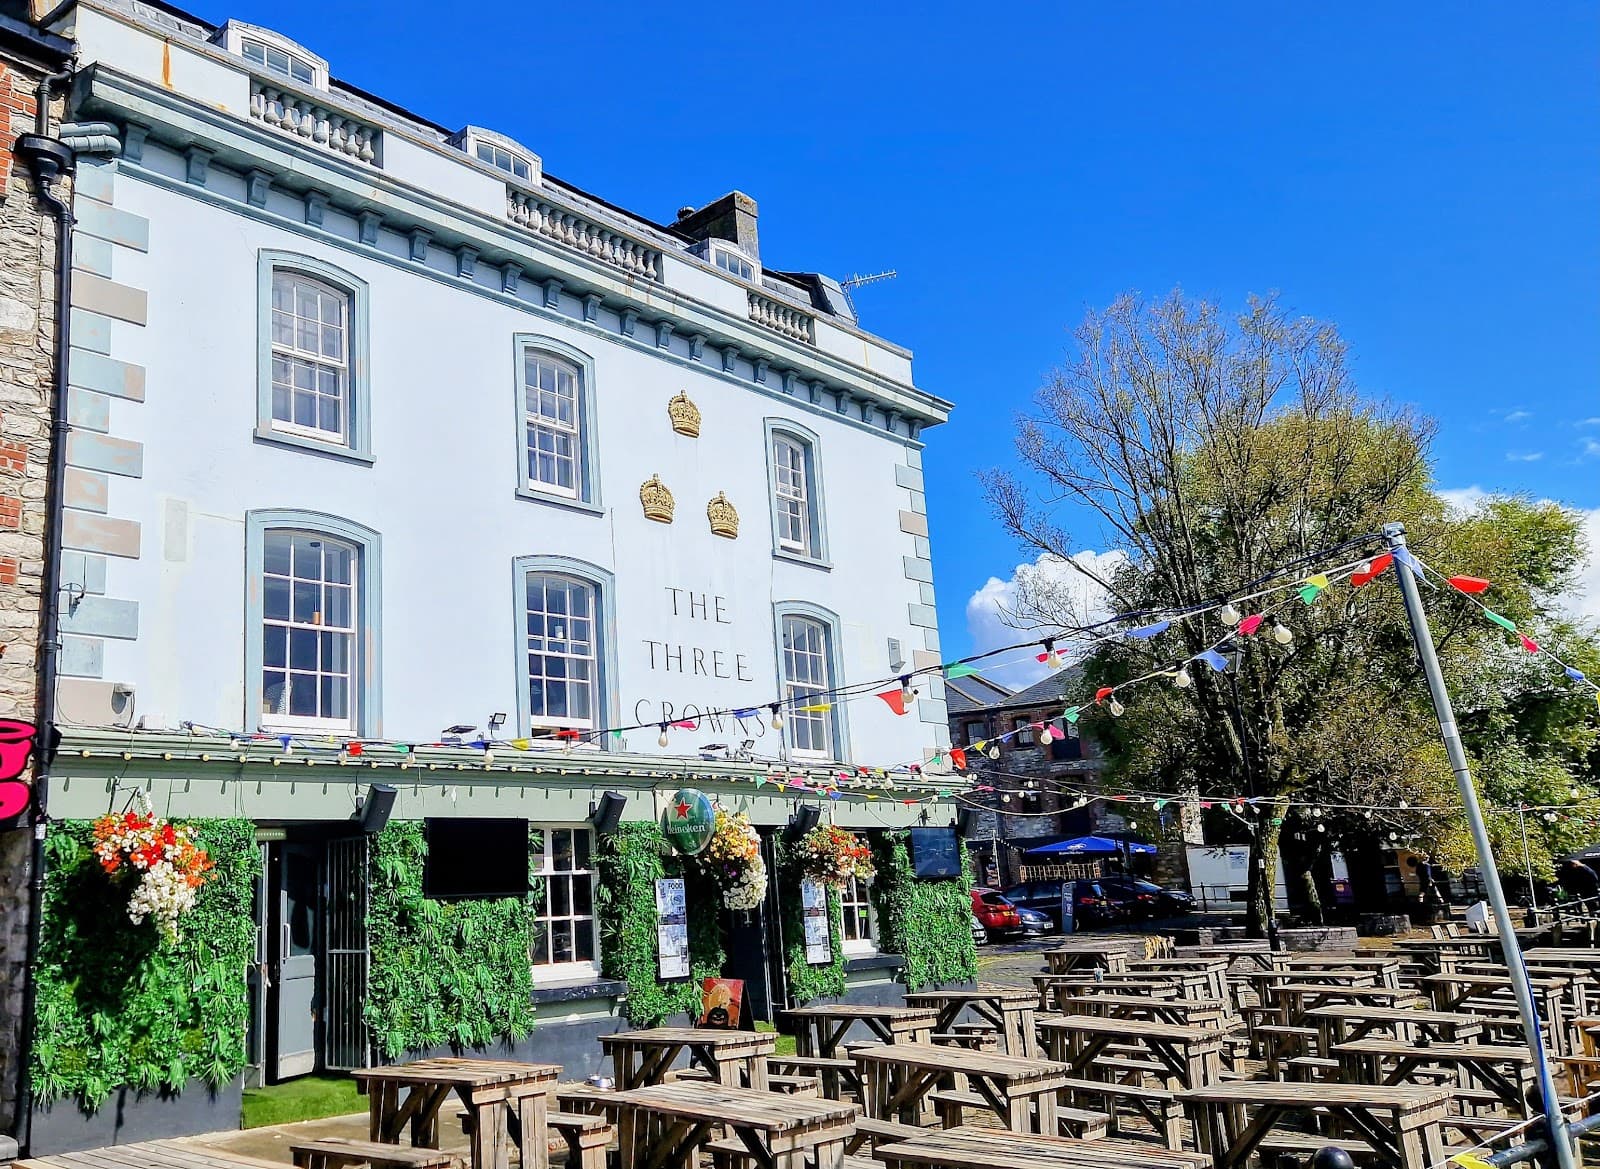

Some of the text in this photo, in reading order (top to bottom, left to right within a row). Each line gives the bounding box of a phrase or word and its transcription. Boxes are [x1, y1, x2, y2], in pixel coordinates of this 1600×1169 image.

[665, 587, 731, 624] THE
[642, 640, 753, 682] THREE
[635, 699, 765, 737] CROWNS
